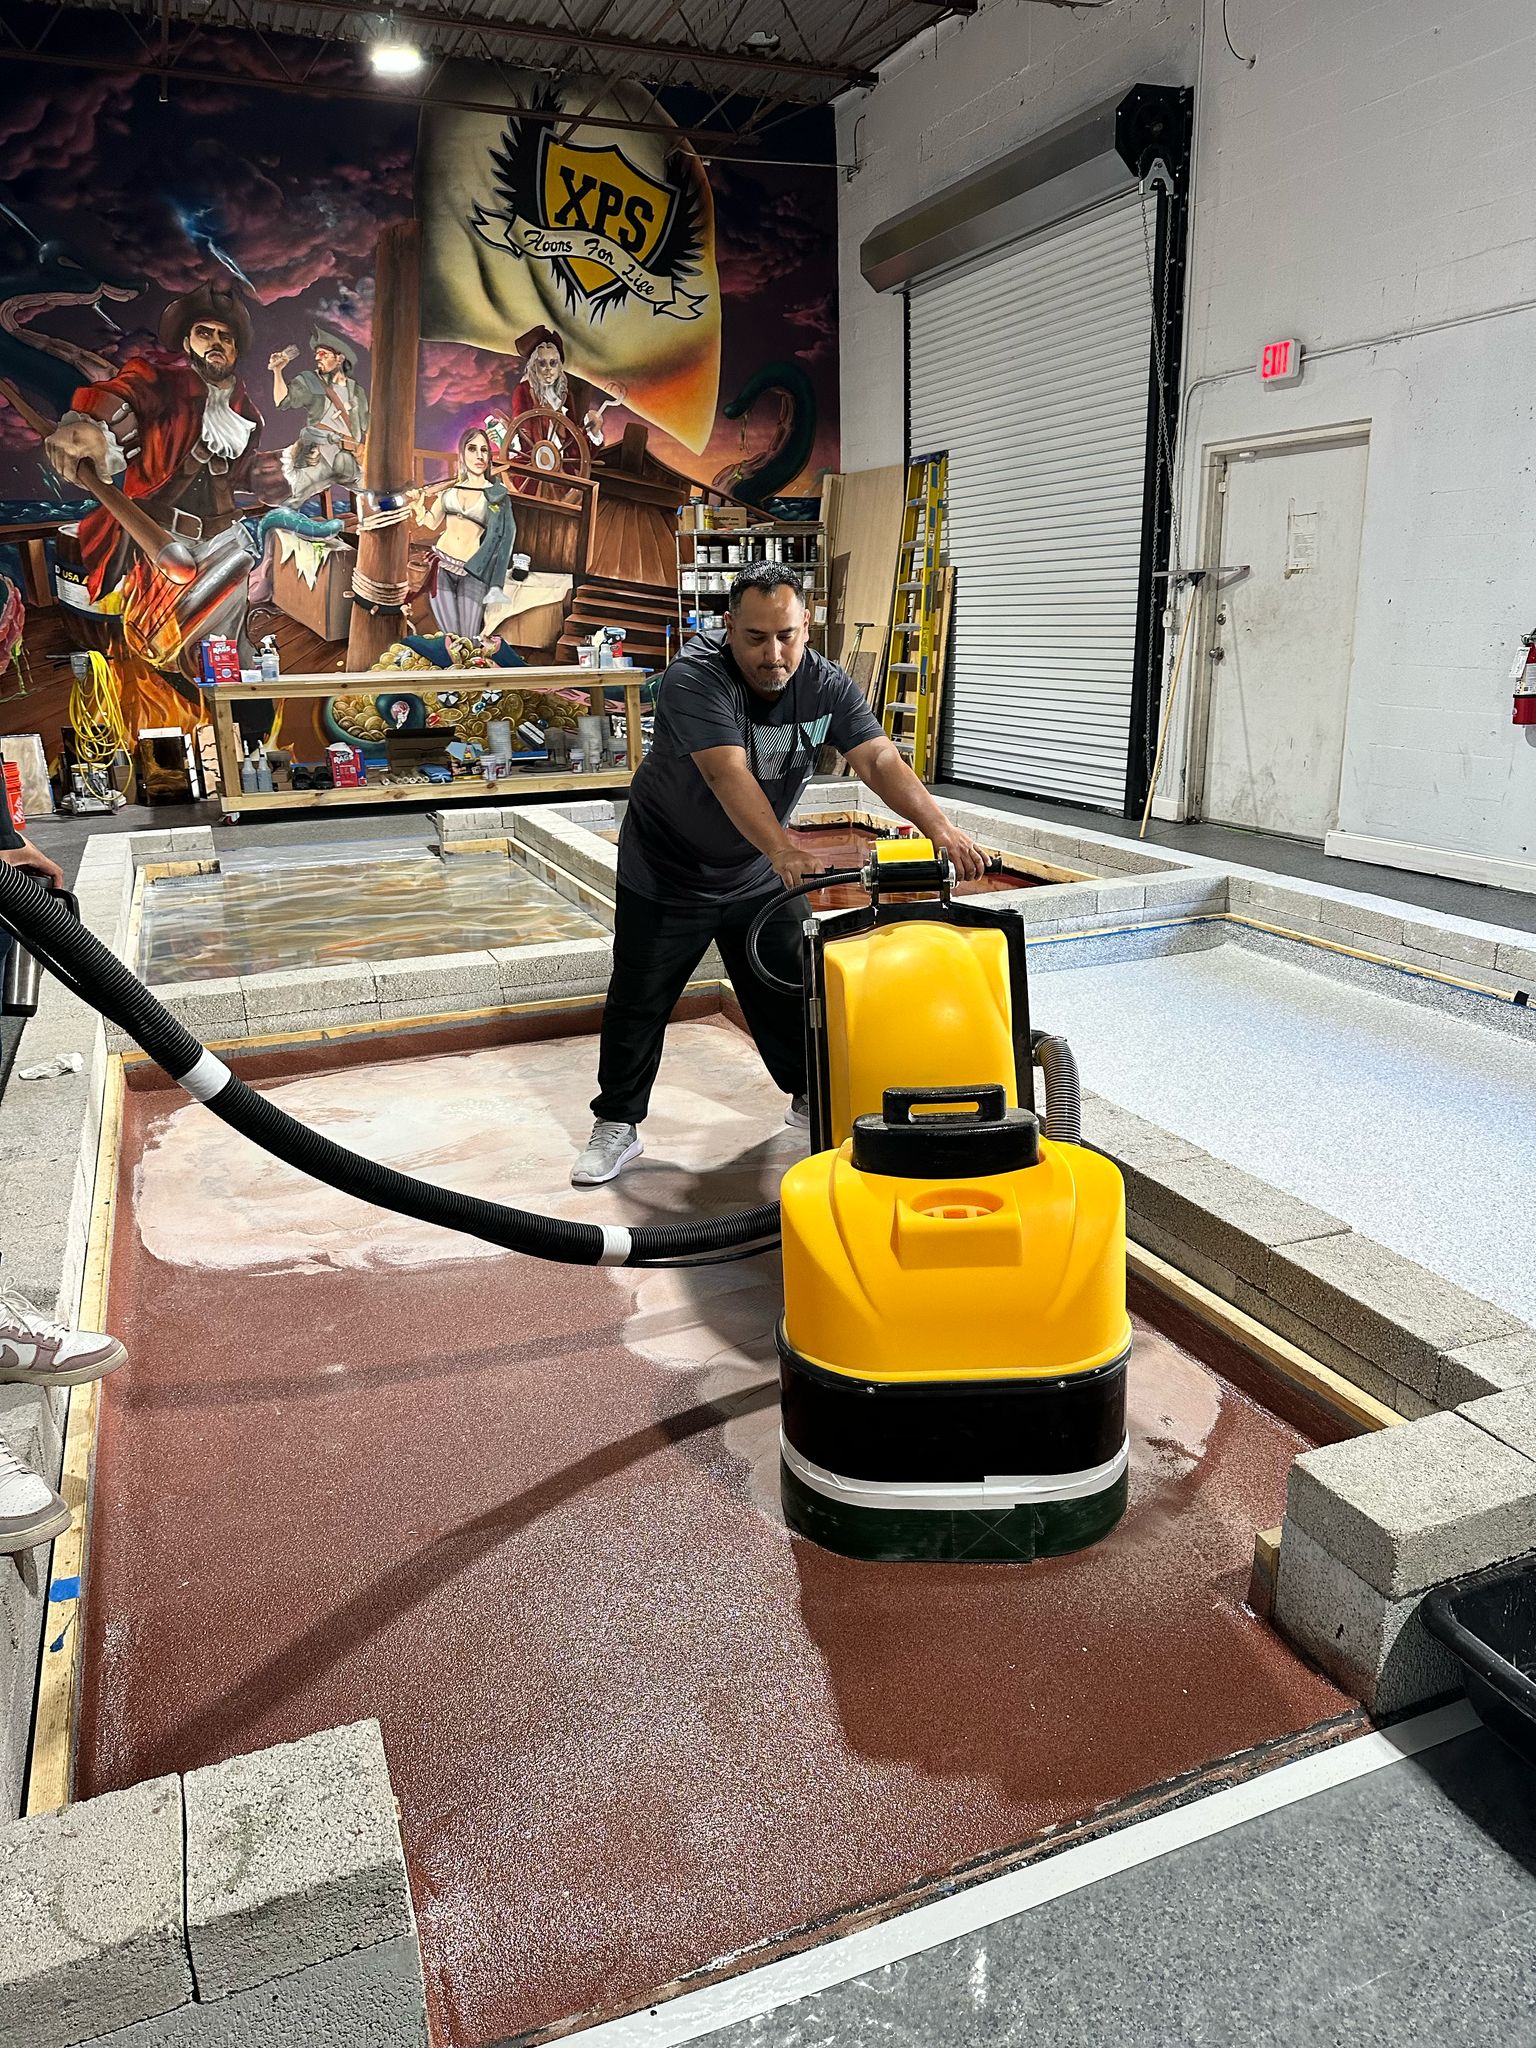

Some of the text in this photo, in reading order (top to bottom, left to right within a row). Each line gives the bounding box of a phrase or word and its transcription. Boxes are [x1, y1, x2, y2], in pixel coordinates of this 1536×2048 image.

[555, 166, 655, 253] XPS
[584, 238, 615, 266] For
[621, 263, 656, 296] Life
[1262, 342, 1290, 378] EXIT
[62, 570, 80, 583] USA
[333, 754, 354, 764] RAGS
